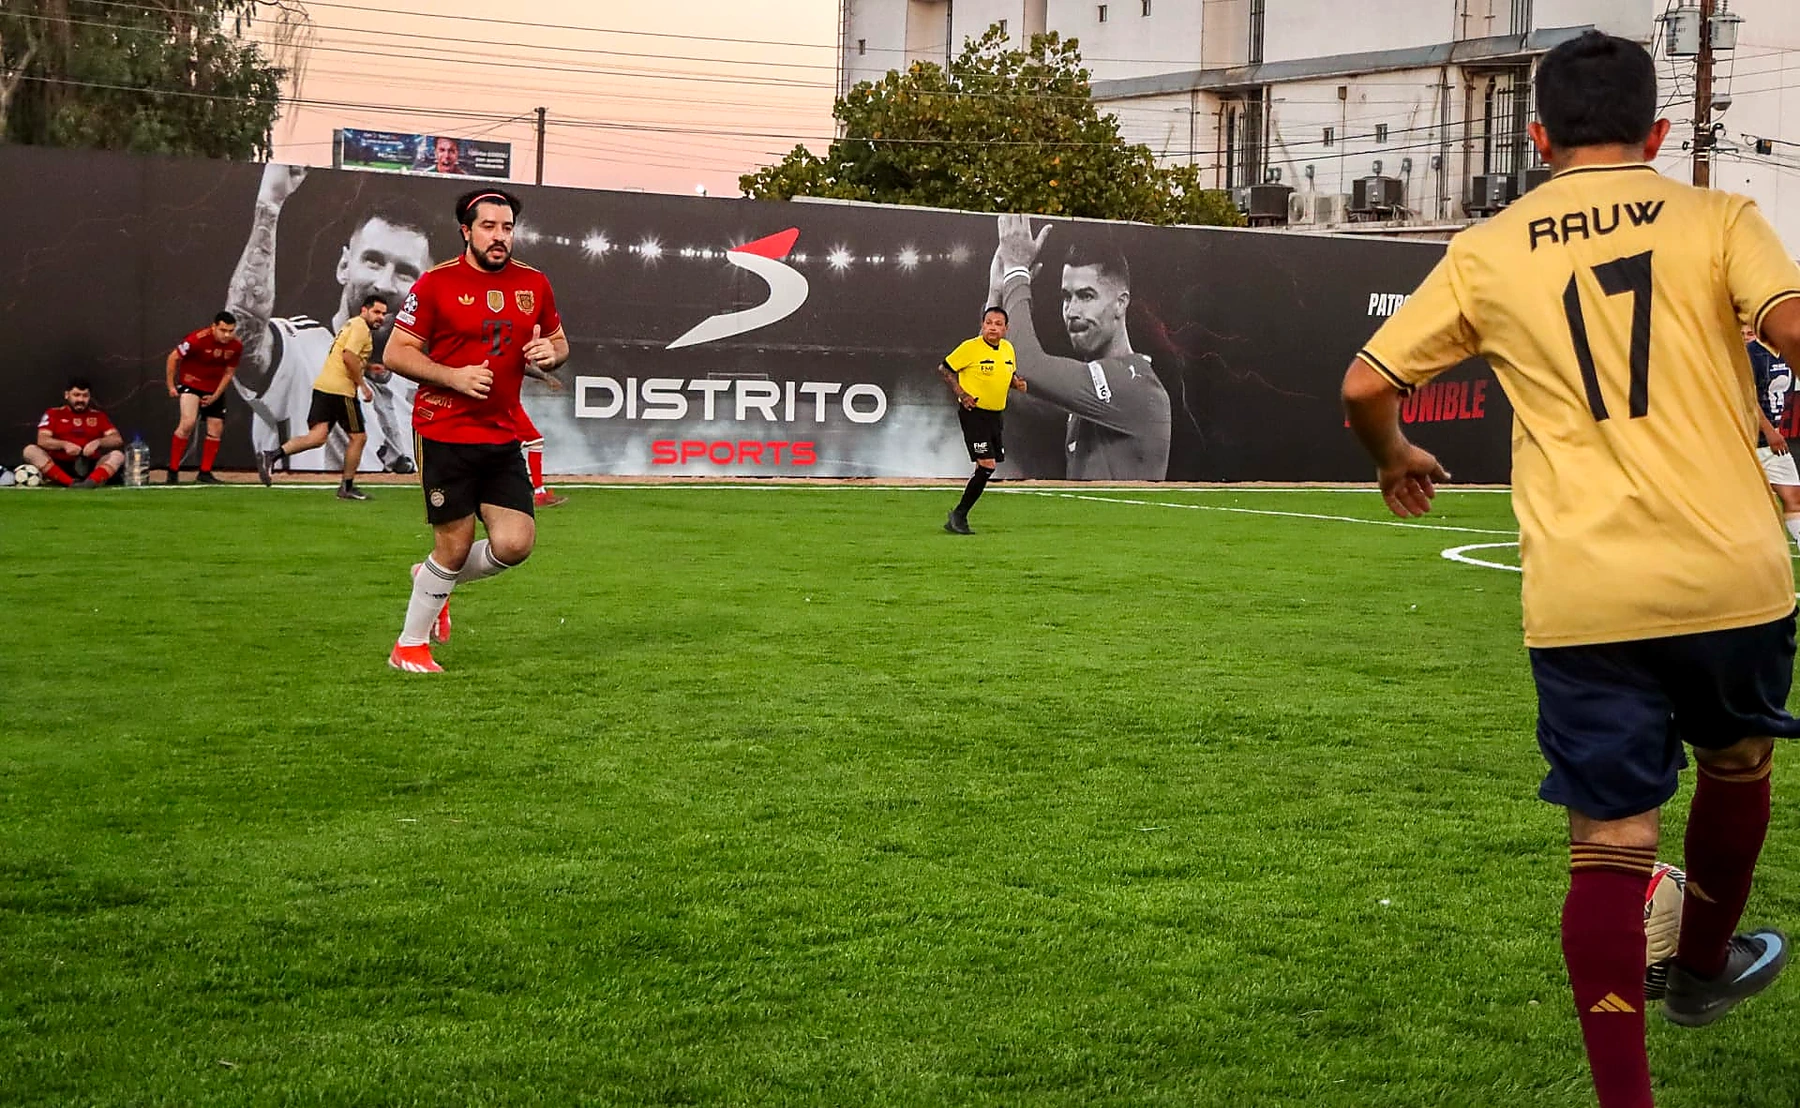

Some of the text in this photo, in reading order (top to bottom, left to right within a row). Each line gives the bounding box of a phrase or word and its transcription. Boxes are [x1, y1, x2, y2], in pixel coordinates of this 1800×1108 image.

[1528, 200, 1665, 252] RAUW
[1367, 292, 1412, 317] PATR
[1562, 249, 1653, 422] 17
[575, 376, 887, 423] DISTRITO
[652, 440, 817, 465] SPORTS
